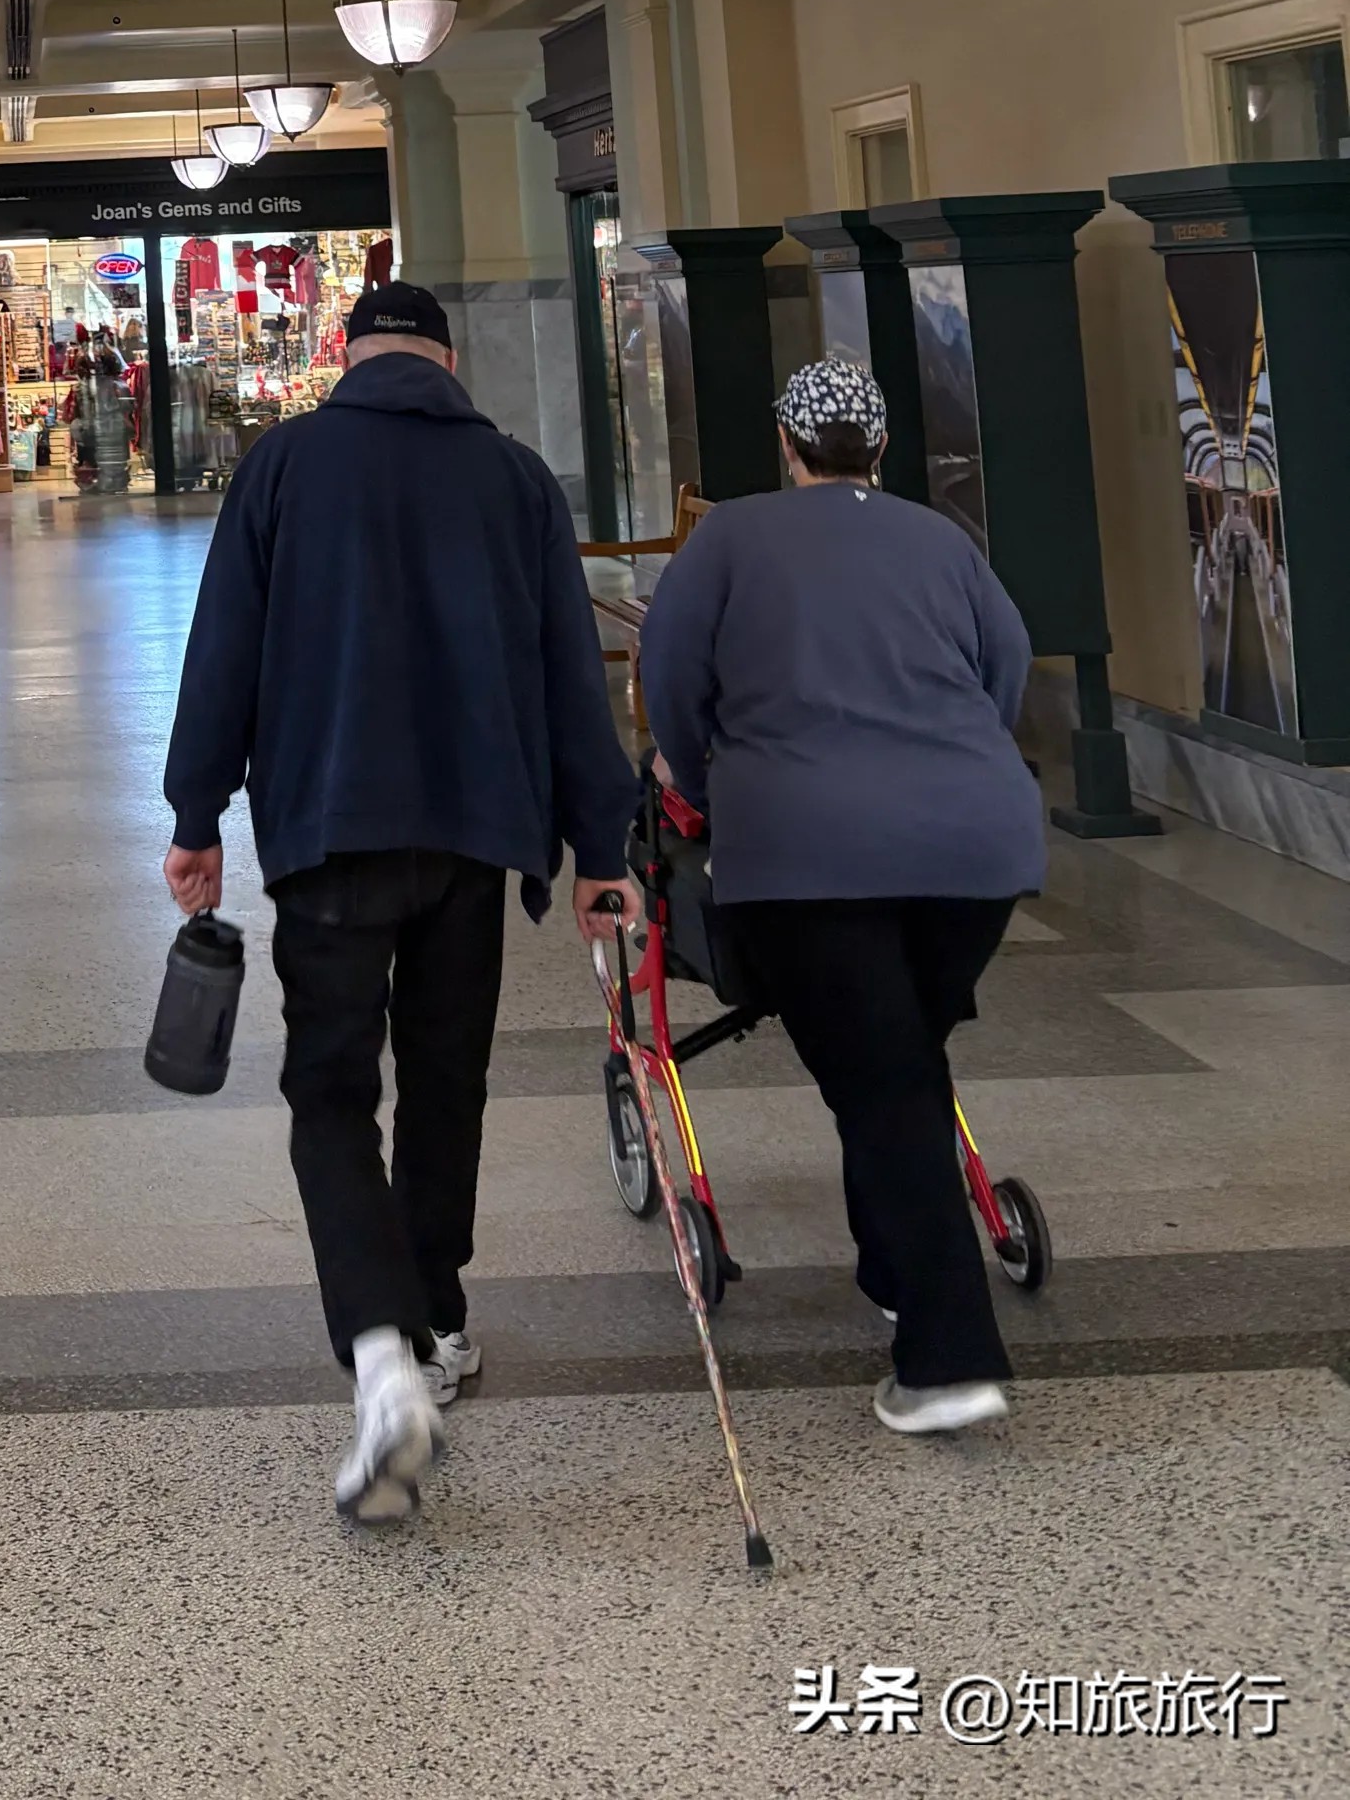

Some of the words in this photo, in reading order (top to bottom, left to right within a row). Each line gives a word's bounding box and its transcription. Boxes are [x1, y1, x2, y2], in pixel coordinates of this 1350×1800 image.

[91, 203, 153, 221] Joan's
[158, 201, 213, 218] Gems
[218, 199, 253, 215] and
[258, 197, 302, 214] Gifts
[96, 260, 139, 275] OPEN
